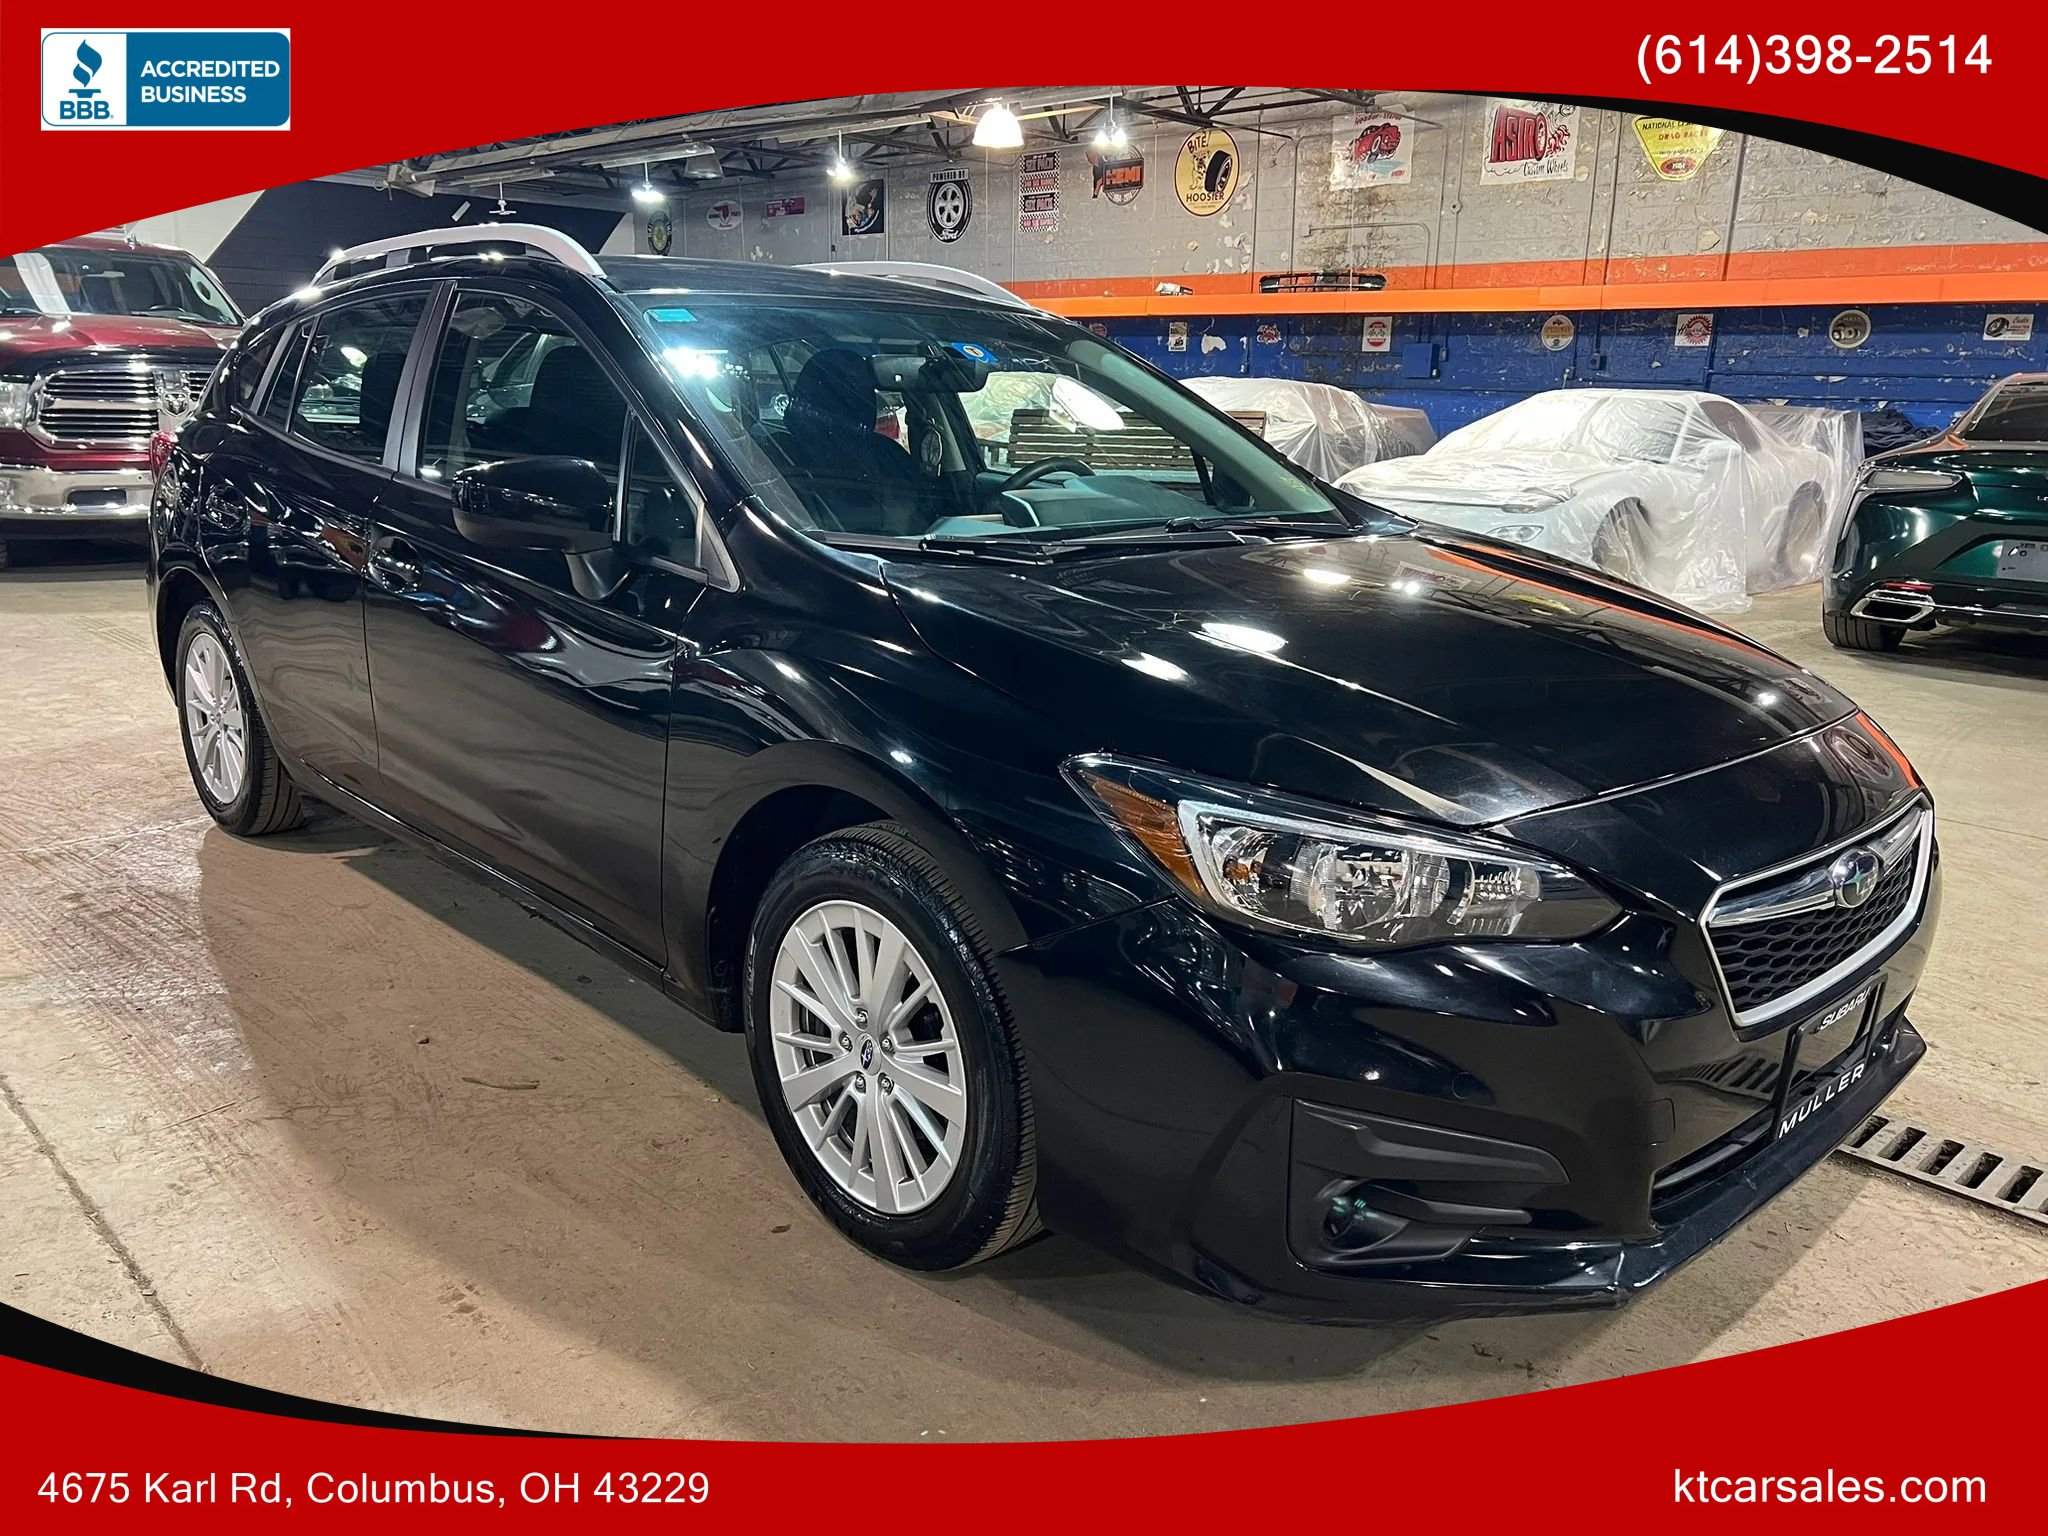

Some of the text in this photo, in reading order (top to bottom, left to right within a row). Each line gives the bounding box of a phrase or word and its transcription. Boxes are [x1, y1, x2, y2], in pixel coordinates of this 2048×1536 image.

[1489, 104, 1547, 163] ASTRO
[1642, 121, 1675, 130] NATIONAL
[1105, 165, 1141, 185] HEMI
[1186, 191, 1225, 203] HOOSIER
[1819, 986, 1871, 1031] SUBARU
[1778, 1063, 1865, 1138] MULLER
